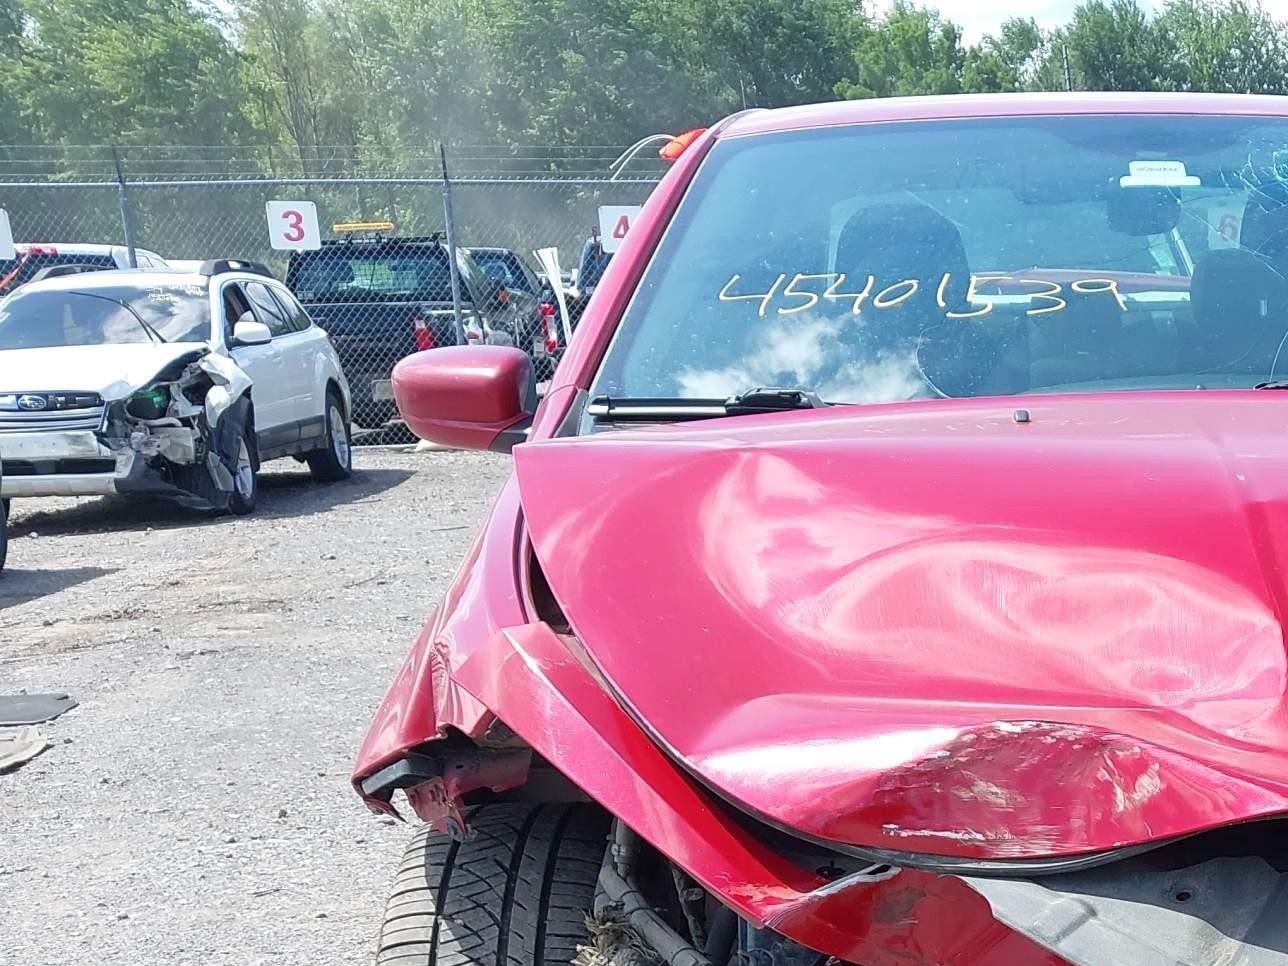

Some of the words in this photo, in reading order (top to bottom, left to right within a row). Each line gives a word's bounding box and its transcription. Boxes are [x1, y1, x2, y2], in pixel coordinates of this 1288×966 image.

[281, 210, 305, 242] 3
[613, 215, 630, 239] 4
[717, 272, 1128, 317] 45401539
